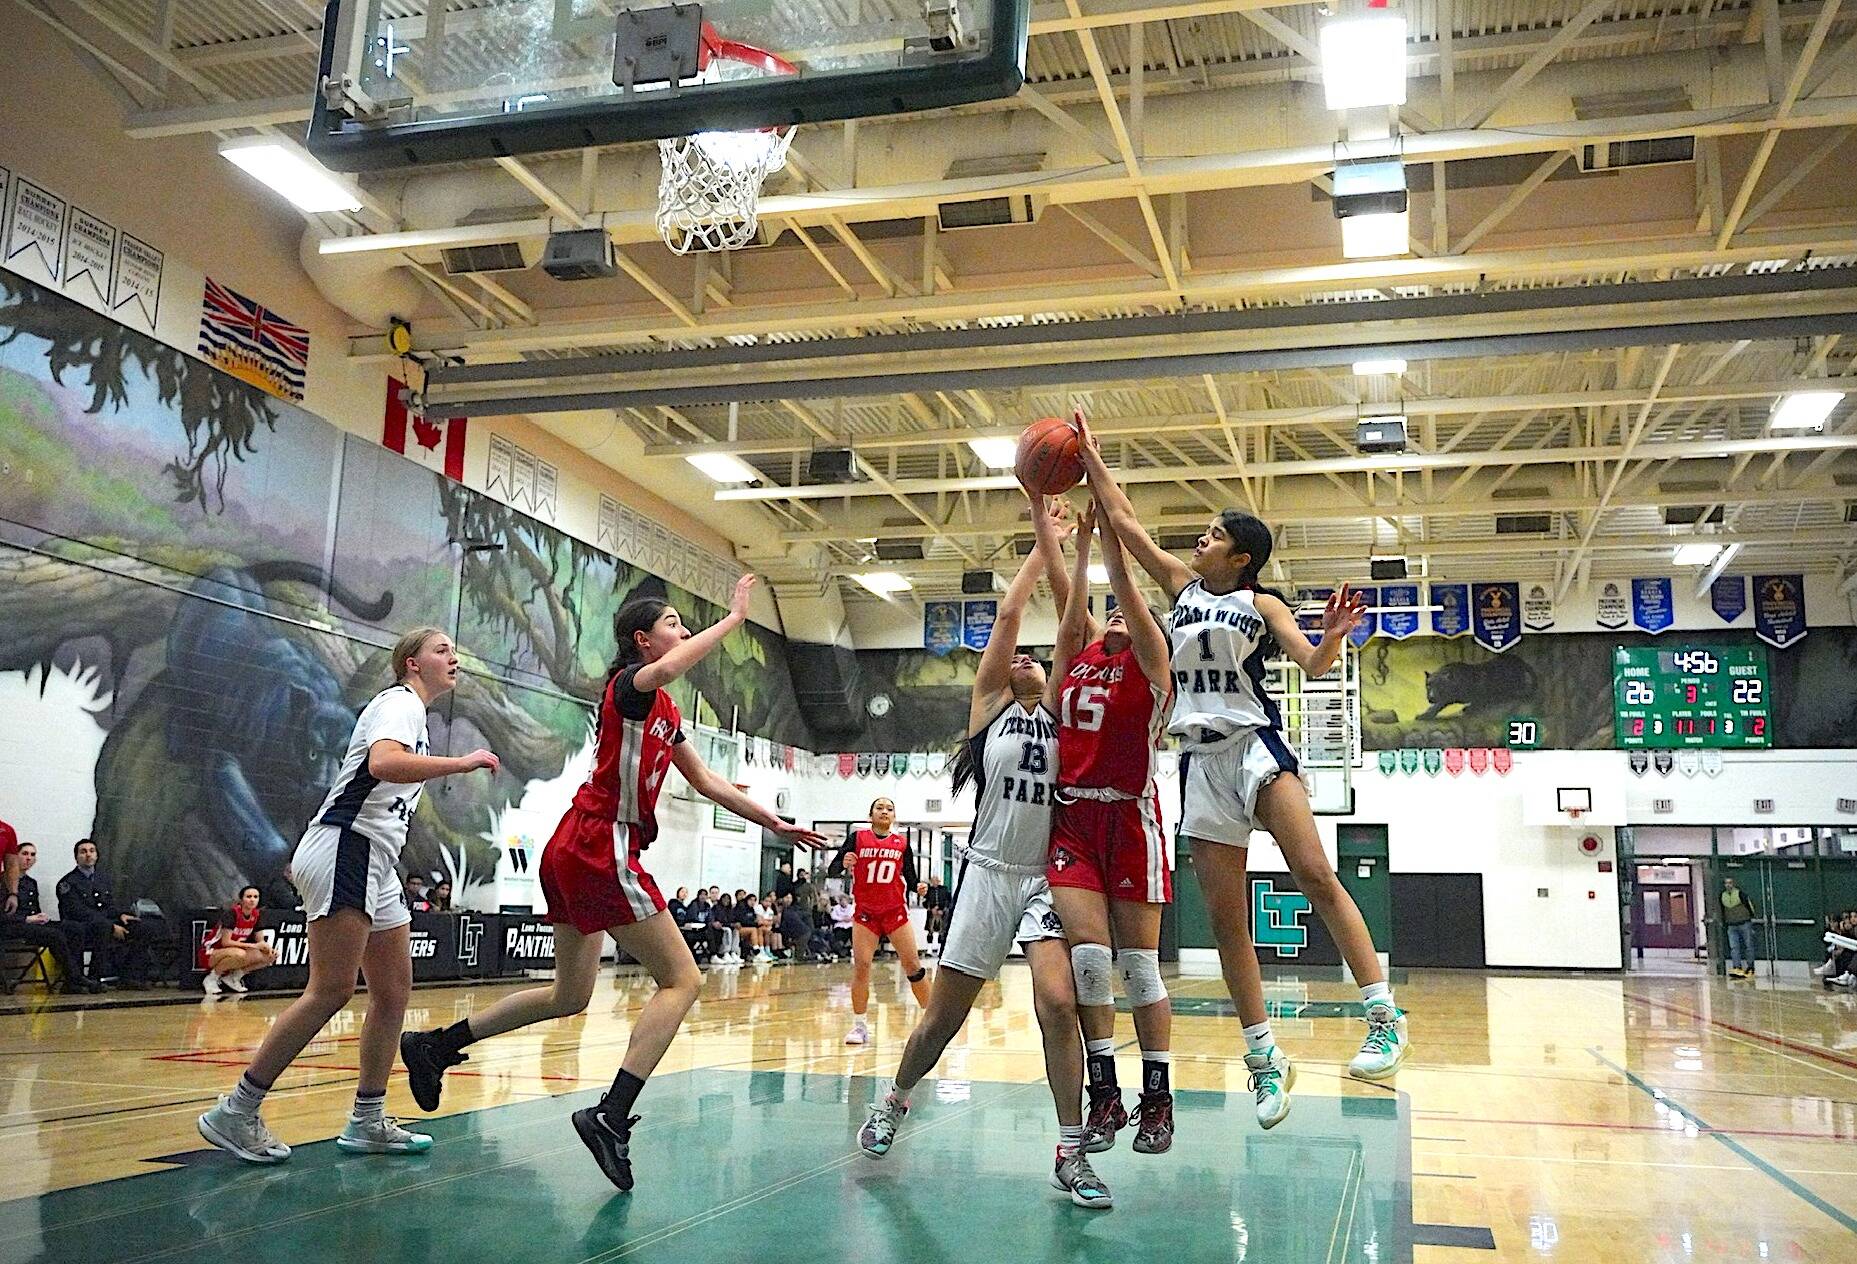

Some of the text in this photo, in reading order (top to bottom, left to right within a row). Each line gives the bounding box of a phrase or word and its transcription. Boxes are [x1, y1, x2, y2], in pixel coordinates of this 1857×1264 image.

[21, 195, 59, 219] CHAMPIONS
[74, 222, 110, 246] CHAMPIONS
[123, 246, 159, 272] CHAMPIONS
[1198, 628, 1215, 661] 1
[1177, 669, 1240, 693] PARK
[1624, 665, 1758, 677] HOME GUEST
[1626, 680, 1762, 705] 26 3 22
[1062, 686, 1110, 732] 15
[1509, 722, 1536, 744] 30
[1633, 719, 1644, 736] 2
[1753, 717, 1765, 736] 2
[1018, 741, 1048, 776] 13
[1655, 799, 1672, 809] EXIT
[1755, 799, 1773, 809] EXIT
[859, 848, 902, 861] HOLY CROSS
[867, 860, 896, 884] 10
[280, 922, 302, 933] LORD
